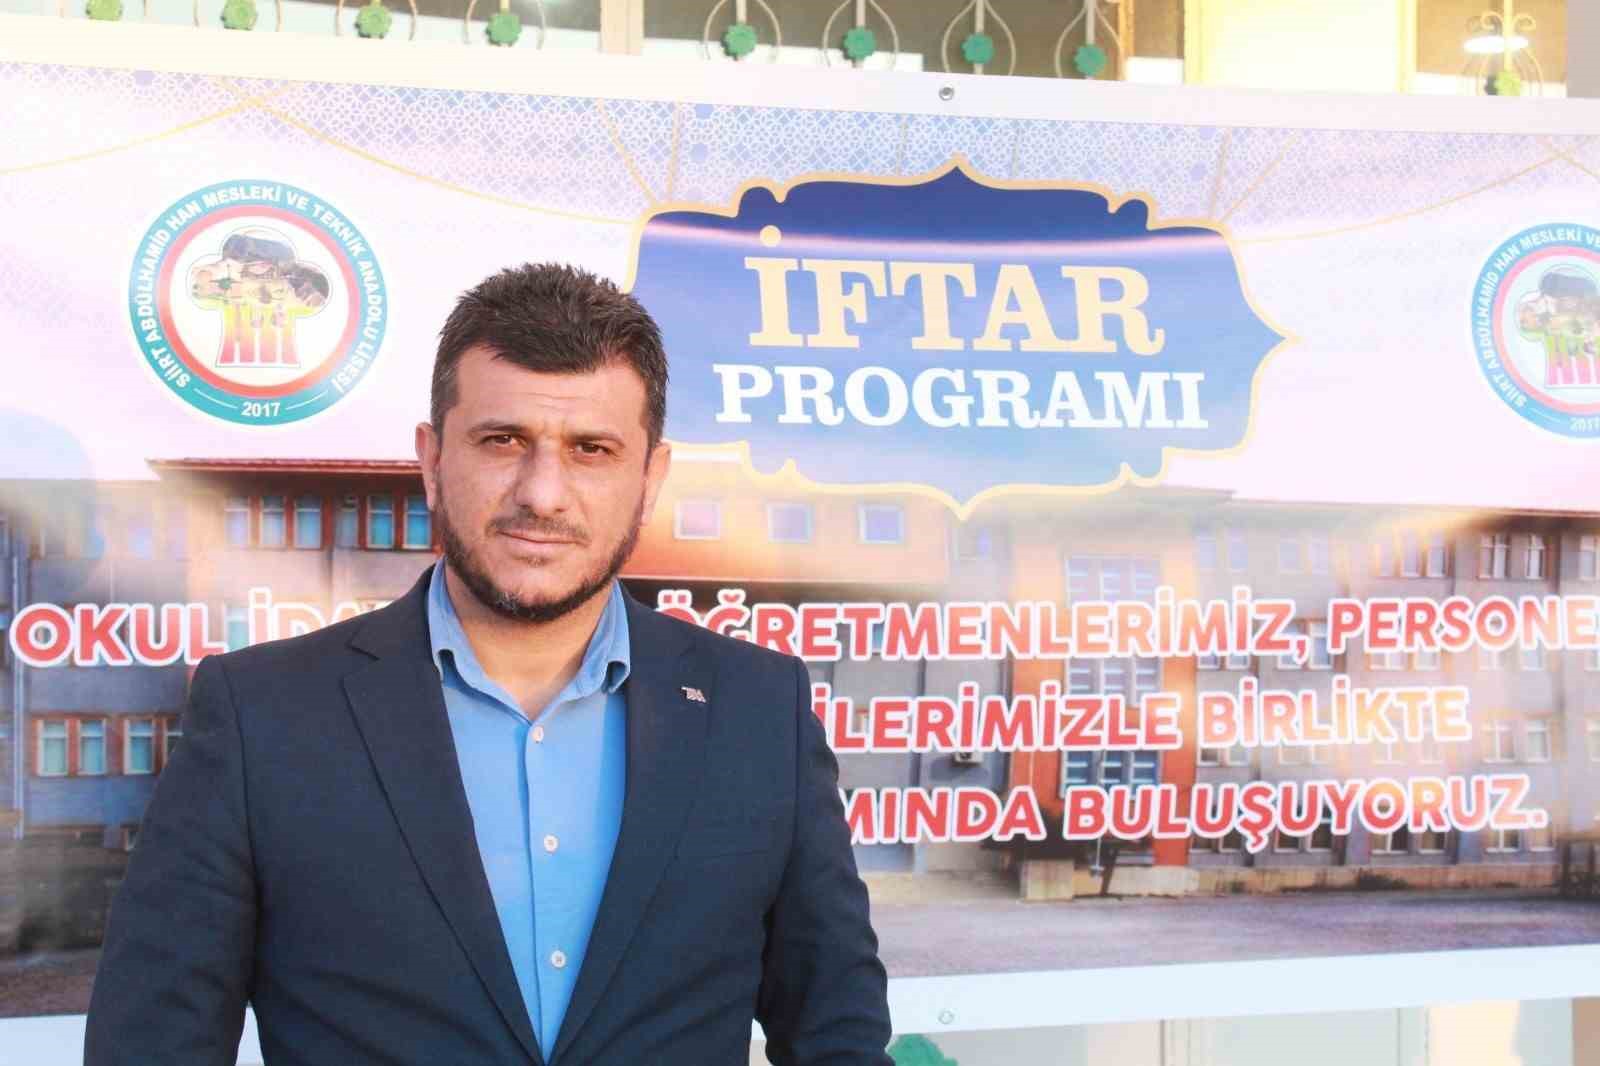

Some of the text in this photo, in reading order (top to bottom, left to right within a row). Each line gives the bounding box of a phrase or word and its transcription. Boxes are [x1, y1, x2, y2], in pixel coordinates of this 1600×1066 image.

[166, 200, 202, 228] HAN
[202, 185, 281, 208] MESLEKİ
[286, 190, 310, 211] VE
[312, 203, 366, 257] TEKNİK
[357, 260, 383, 339] ANADOLU
[743, 224, 1166, 357] İFTAR
[241, 402, 281, 418] 2017
[712, 362, 1209, 431] PROGRAMI
[9, 602, 228, 667] OKUL
[1198, 676, 1472, 749] BİRLİKTE
[1063, 773, 1548, 853] BULUŞUYORUZ.
